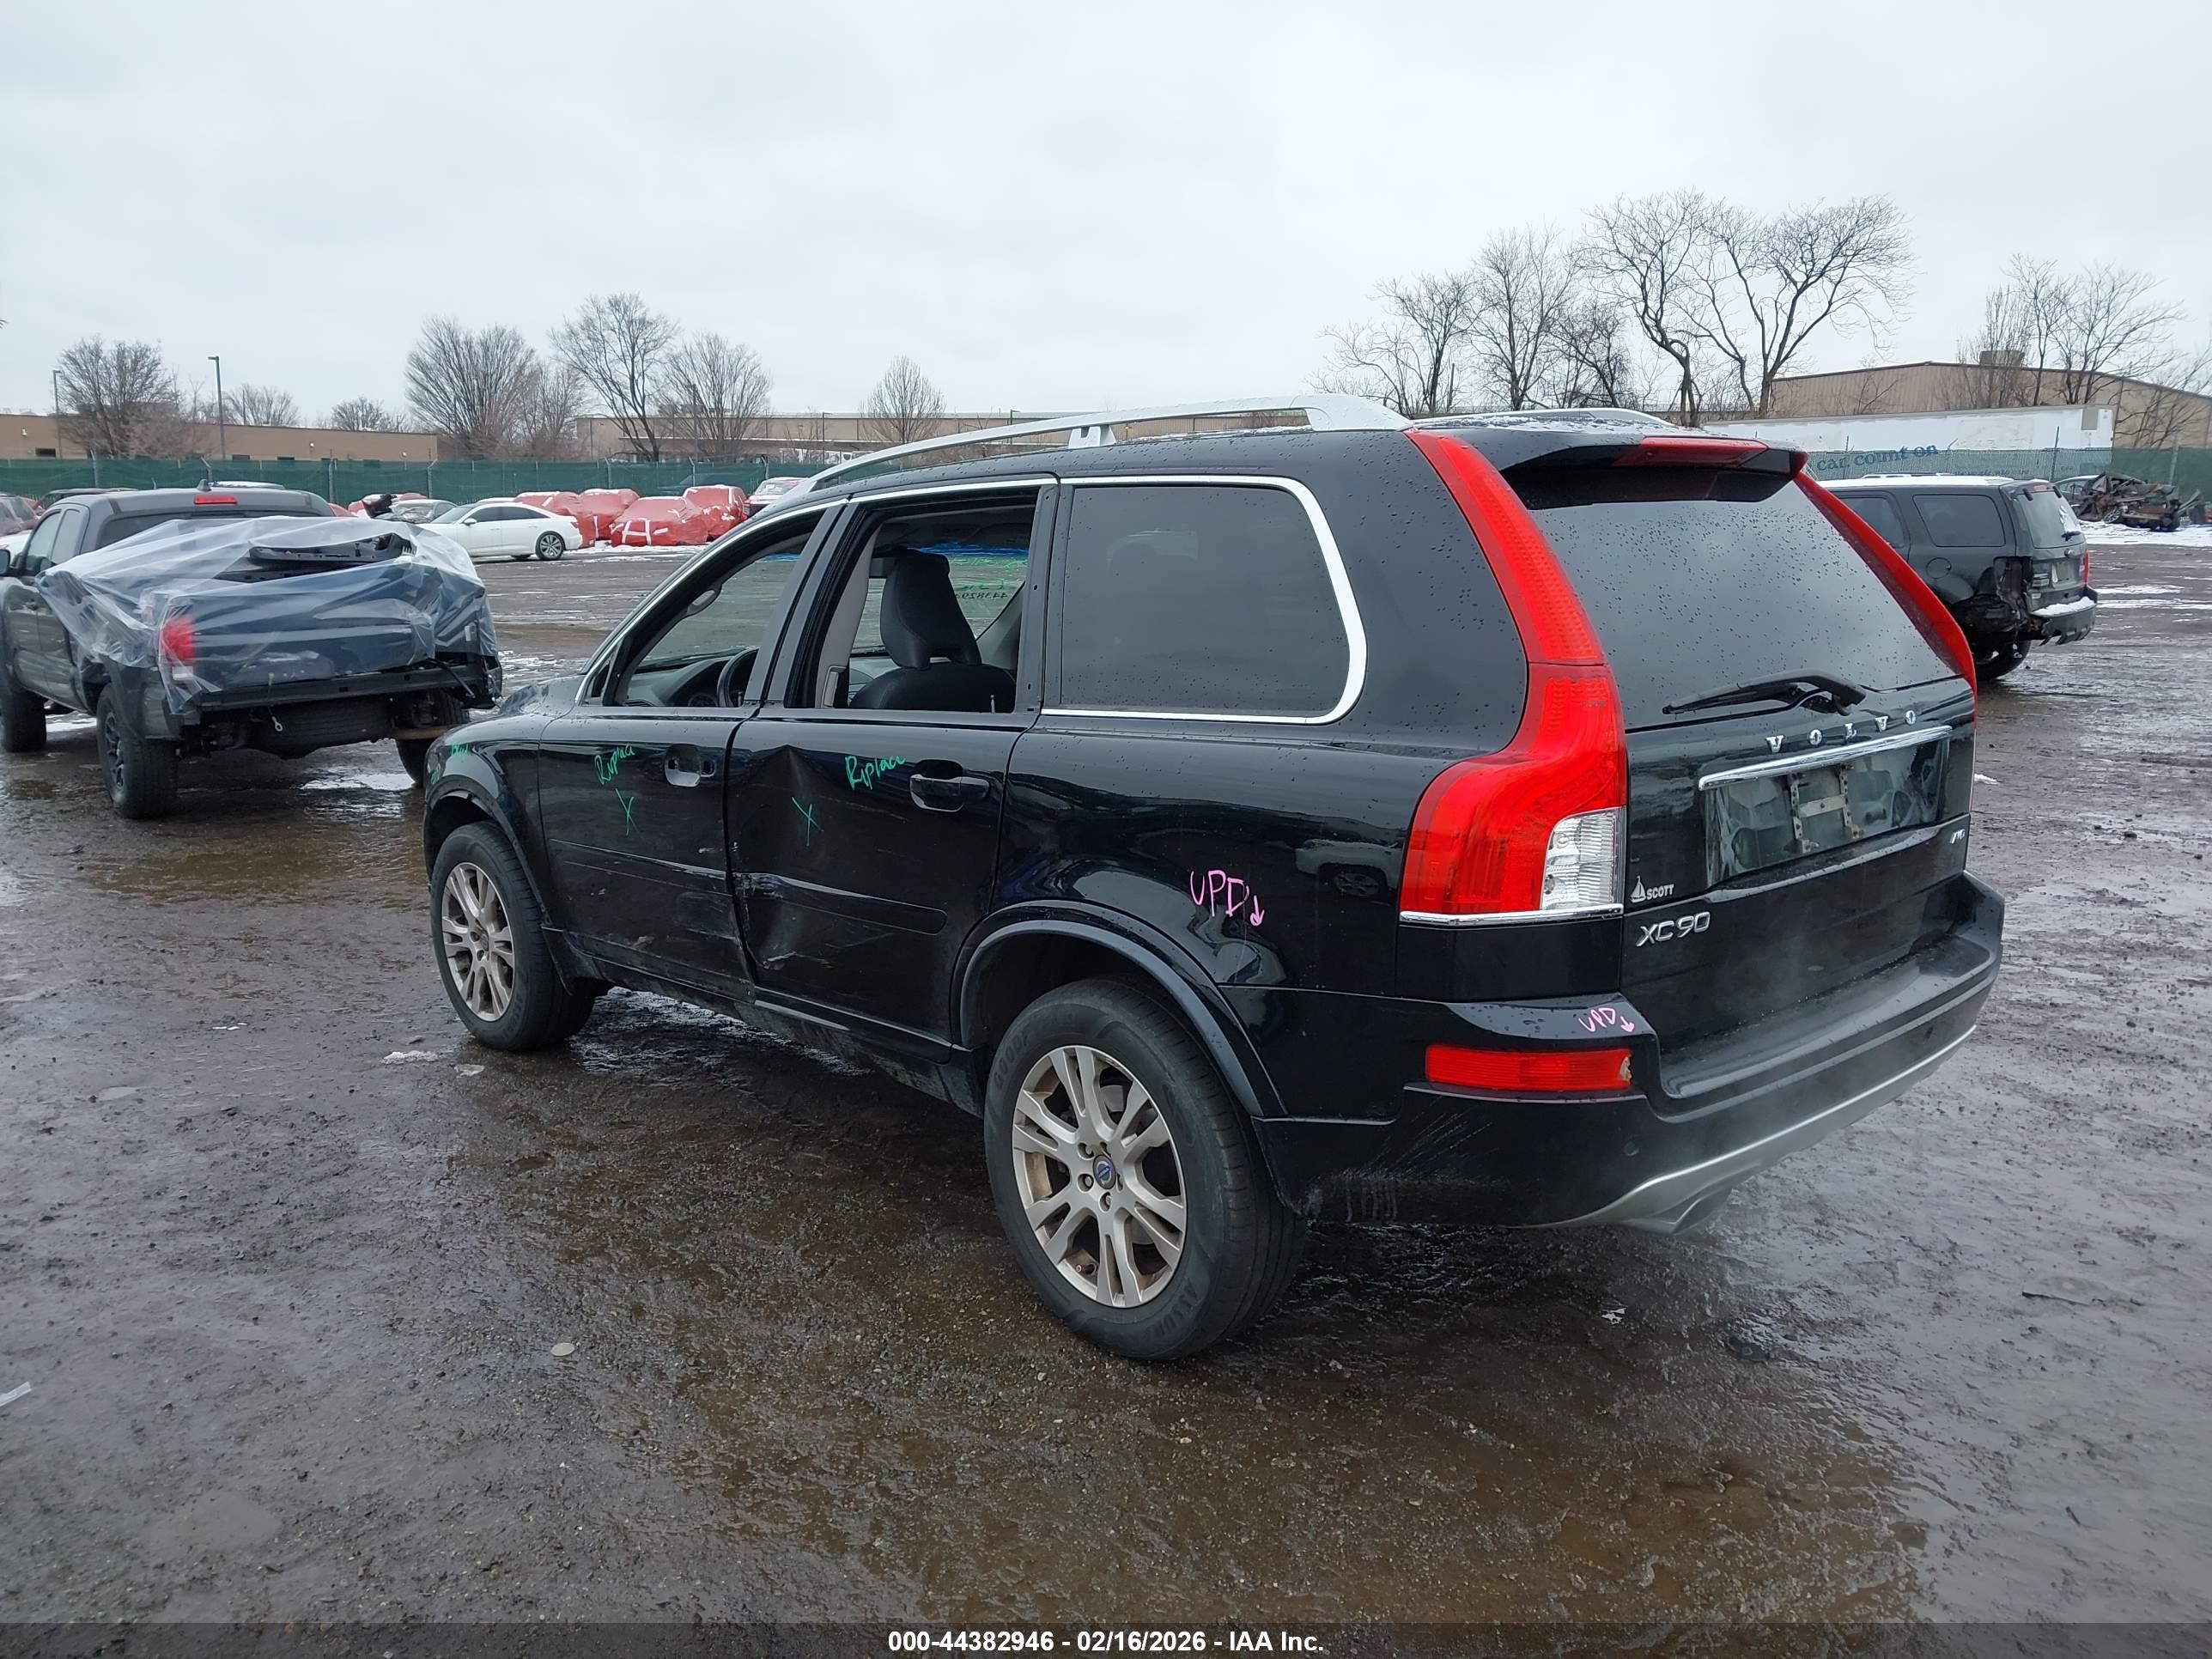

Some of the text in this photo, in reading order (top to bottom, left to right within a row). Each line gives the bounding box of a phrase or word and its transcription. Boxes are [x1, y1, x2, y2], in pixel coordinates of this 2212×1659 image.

[1854, 446, 1909, 466] count
[1914, 444, 1939, 458] on
[1765, 708, 1917, 753] VOLVO
[1646, 883, 1674, 900] SCOTT
[1636, 911, 1711, 948] XC90
